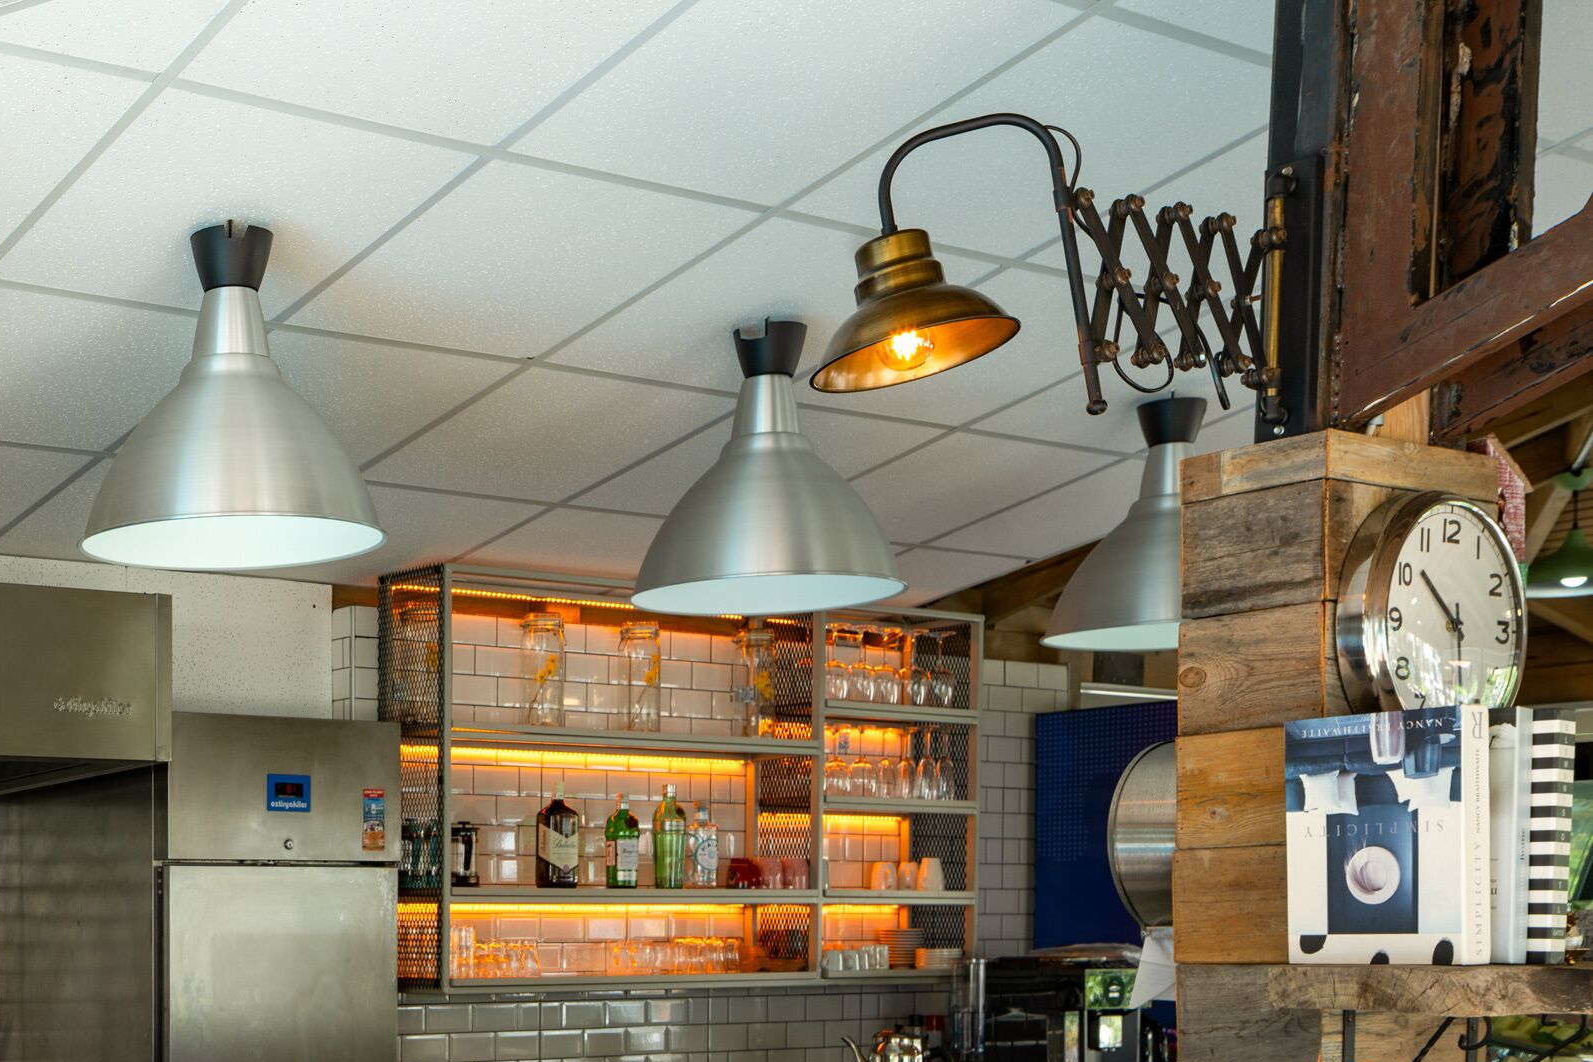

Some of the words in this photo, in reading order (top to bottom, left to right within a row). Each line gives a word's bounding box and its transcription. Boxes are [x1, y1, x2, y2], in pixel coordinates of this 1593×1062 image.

[1420, 527, 1431, 553] 11
[1442, 518, 1462, 544] 12
[1398, 562, 1413, 586] 10
[1489, 573, 1503, 597] 2
[1388, 607, 1403, 631] 9
[1495, 620, 1510, 645] 3
[1394, 656, 1411, 680] 8
[1398, 718, 1444, 731] NANCY
[1304, 819, 1444, 838] SIMPLICITY
[1474, 842, 1482, 956] SIMPLICITY
